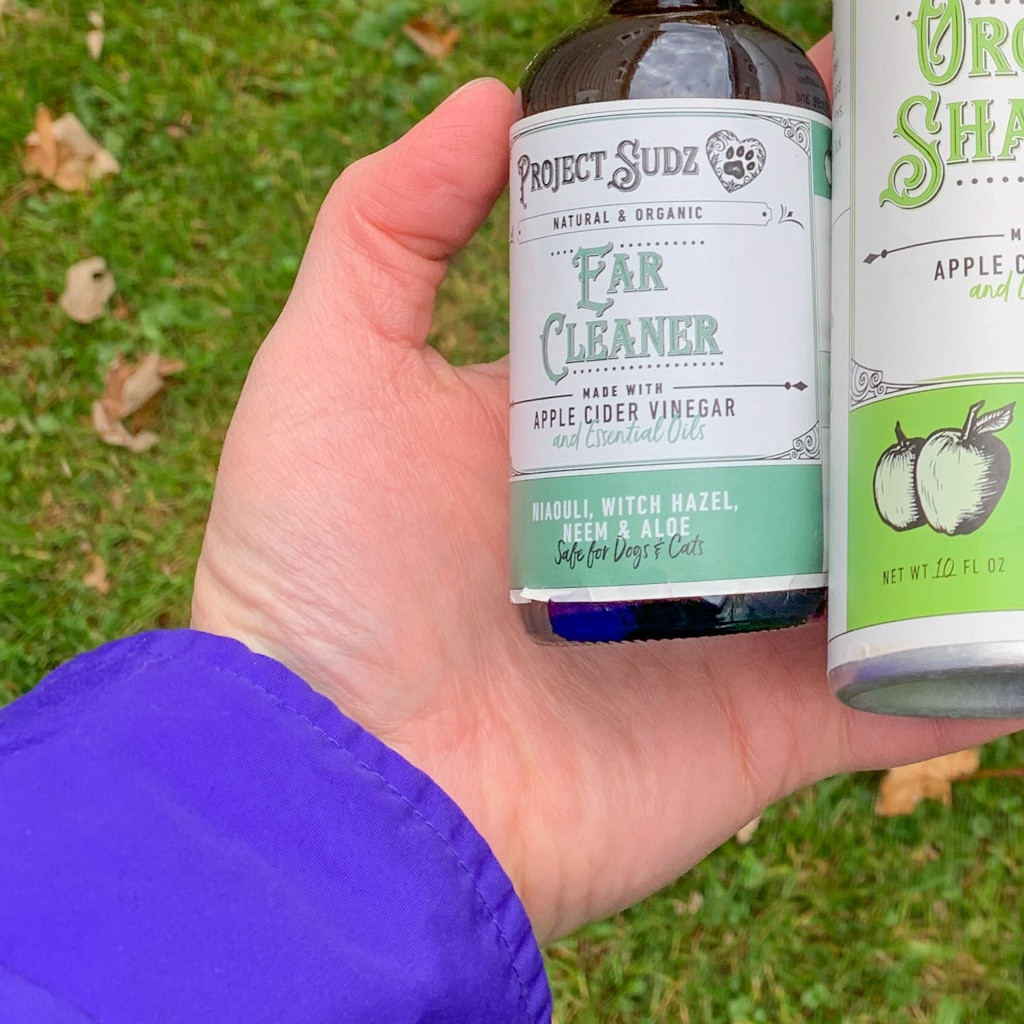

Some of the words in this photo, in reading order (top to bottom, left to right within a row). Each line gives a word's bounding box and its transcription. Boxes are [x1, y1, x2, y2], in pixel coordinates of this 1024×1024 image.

[516, 150, 608, 210] PROJECT
[606, 138, 701, 193] SUDZ
[552, 212, 611, 230] NATURAL
[617, 210, 627, 223] &
[635, 206, 704, 222] ORGANIC
[571, 240, 669, 317] EAR
[933, 254, 1004, 282] APPLE
[968, 274, 1011, 302] and
[539, 312, 724, 385] CLEANER
[582, 387, 619, 400] MADE
[626, 382, 664, 396] WITH
[533, 406, 576, 430] APPLE
[584, 402, 639, 425] CIDER
[649, 397, 736, 422] VINEGAR
[551, 424, 584, 450] and
[586, 417, 664, 449] Essential
[666, 413, 706, 443] Oils
[532, 498, 595, 521] NIAOULI,
[601, 495, 662, 517] WITCH
[671, 491, 740, 514] HAZEL,
[563, 523, 608, 543] NEEM
[618, 521, 631, 539] &
[641, 516, 690, 539] ALOE
[554, 539, 586, 570] Safe
[586, 540, 610, 570] for
[613, 535, 651, 570] Dogs
[668, 533, 705, 559] Cats
[882, 567, 905, 586] NET
[910, 563, 929, 581] WT
[931, 556, 958, 579] 10
[963, 559, 979, 575] FL
[987, 557, 1006, 574] OZ
